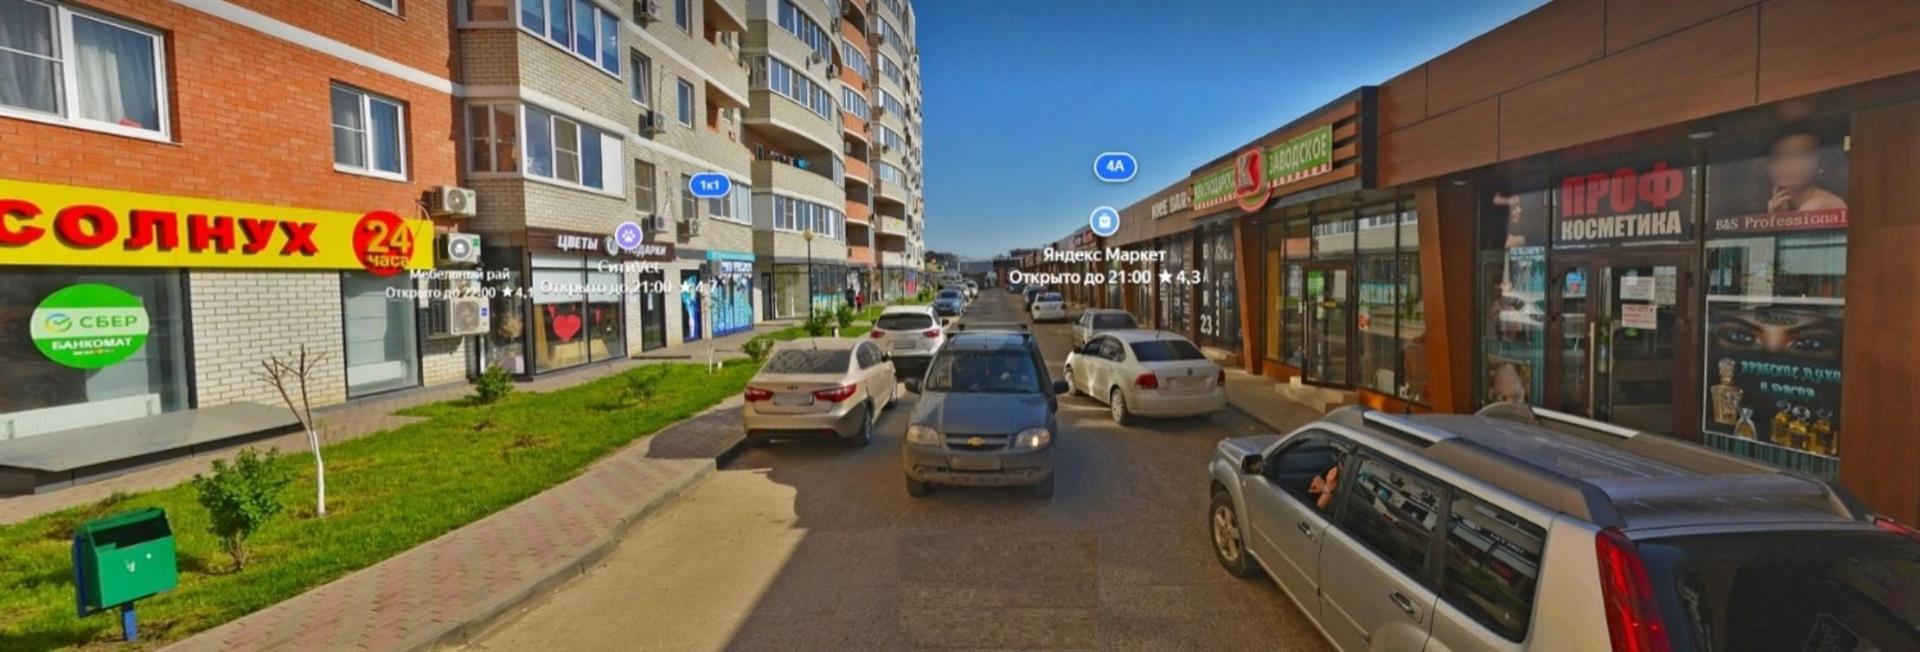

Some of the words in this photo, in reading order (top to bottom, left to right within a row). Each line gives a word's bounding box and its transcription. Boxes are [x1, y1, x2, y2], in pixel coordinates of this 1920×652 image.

[1269, 132, 1327, 175] ЗАВОДСКОЕ
[1561, 161, 1684, 217] ПРОФ
[1561, 210, 1682, 241] КОСМЕТИКА
[1715, 218, 1738, 231] B&S
[1745, 209, 1846, 228] Professional
[366, 219, 410, 253] 24
[557, 235, 598, 251] ЦВЕТЫ
[367, 254, 410, 268] часа
[80, 315, 138, 329] СБЕР
[1200, 313, 1212, 335] 23
[52, 337, 133, 350] БАНКОМАТ
